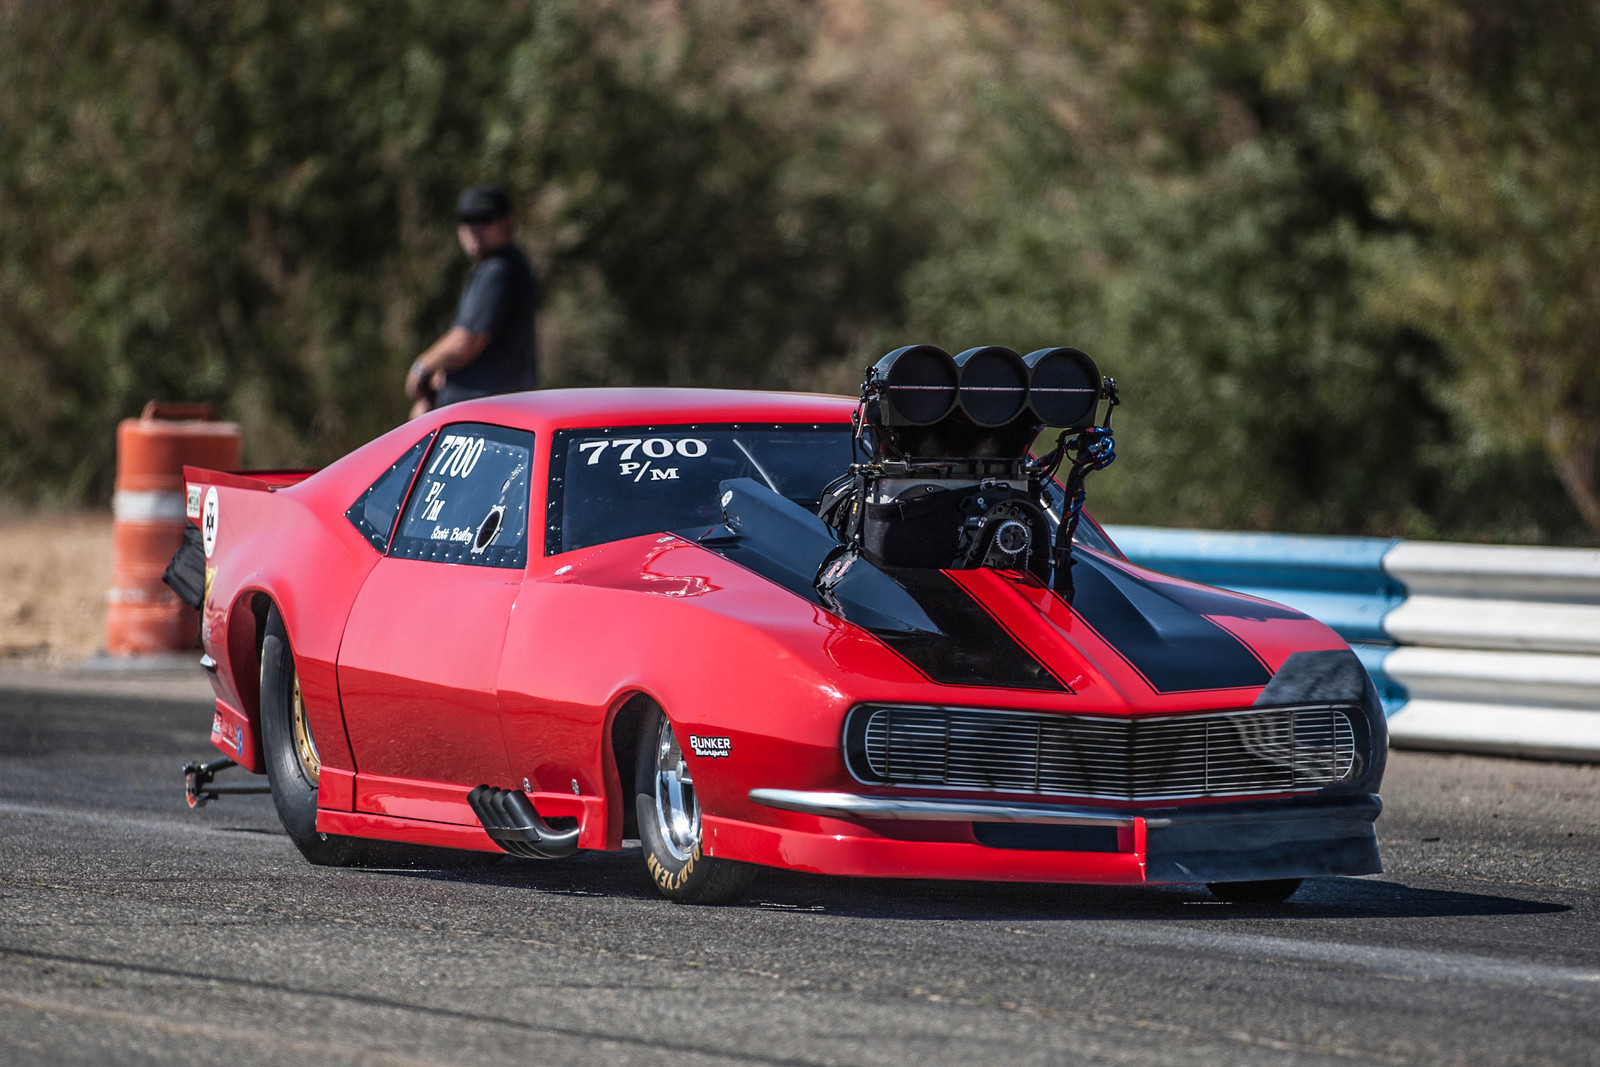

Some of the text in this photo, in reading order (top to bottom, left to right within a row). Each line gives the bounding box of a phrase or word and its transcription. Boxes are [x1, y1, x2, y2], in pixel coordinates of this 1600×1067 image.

[428, 435, 485, 478] 7700
[579, 438, 708, 466] 7700
[619, 461, 680, 482] P/M
[430, 525, 474, 545] Scott Bailey
